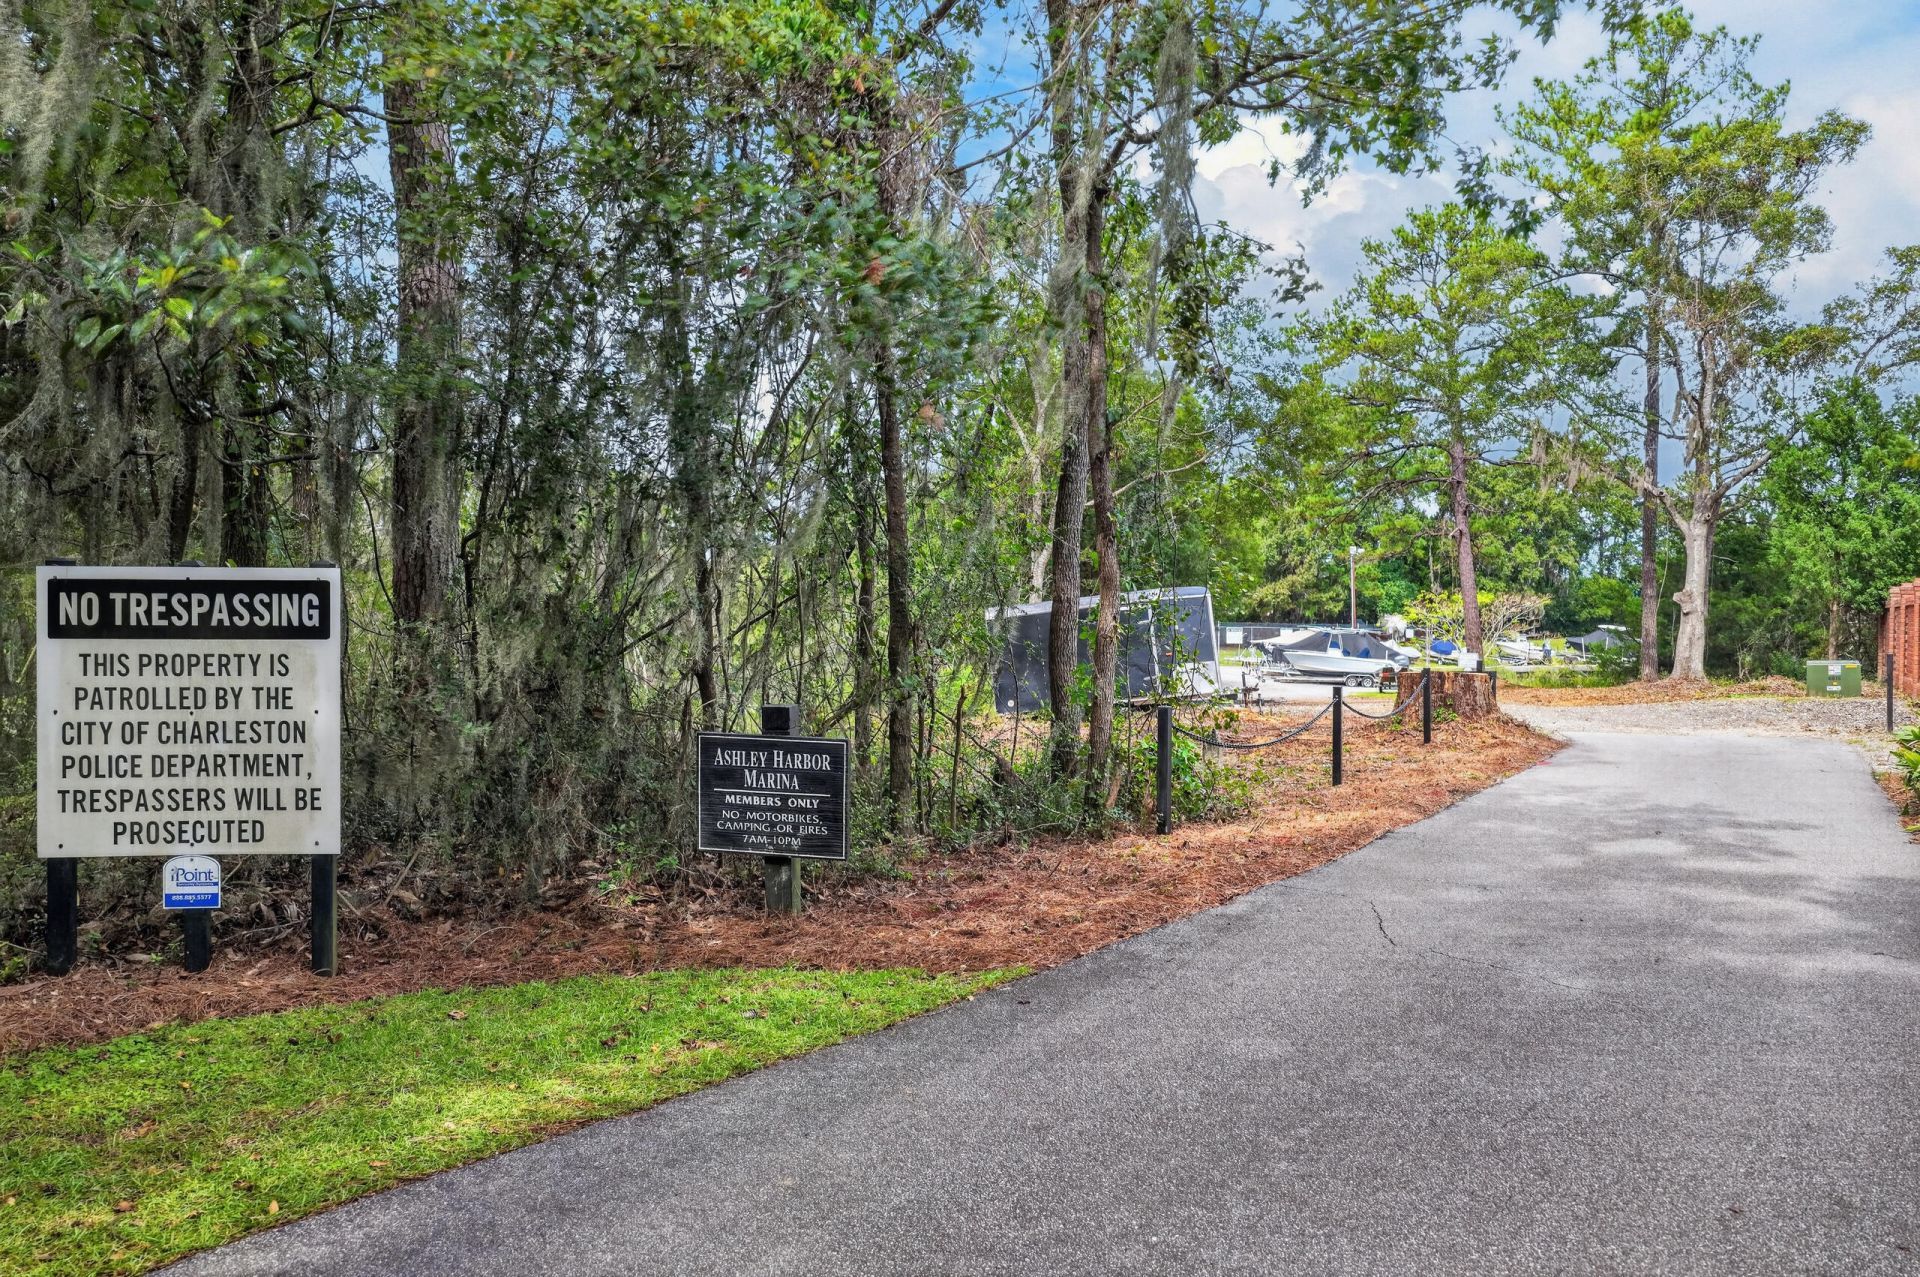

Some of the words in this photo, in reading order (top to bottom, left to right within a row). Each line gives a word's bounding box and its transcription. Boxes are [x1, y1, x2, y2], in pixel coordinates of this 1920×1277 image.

[59, 592, 99, 626] NO
[109, 592, 320, 627] TRESPASSING
[79, 653, 130, 677] THIS
[138, 653, 261, 677] PROPERTY
[270, 653, 290, 677] IS
[74, 686, 207, 710] PATROLLED
[215, 686, 243, 710] BY
[252, 686, 294, 710] THE
[61, 721, 112, 745] CITY
[121, 721, 149, 745] OF
[158, 720, 306, 744] CHARLESTON
[62, 754, 142, 778] POLICE
[151, 754, 312, 780] DEPARTMENT,
[714, 748, 767, 768] ASHLEY
[773, 750, 831, 770] HARBOR
[744, 769, 799, 790] MARINA
[57, 787, 226, 812] TRESPASSERS
[234, 787, 287, 811] WILL
[294, 787, 322, 811] BE
[725, 795, 781, 807] MEMBERS
[788, 799, 819, 808] ONLY
[723, 810, 739, 819] NO
[113, 820, 265, 845] PROSECUTED
[717, 821, 770, 832] CAMPING
[776, 824, 793, 833] OR
[800, 826, 828, 835] FIRES
[743, 835, 801, 845] 7AM-10PM
[171, 868, 214, 882] iPoint
